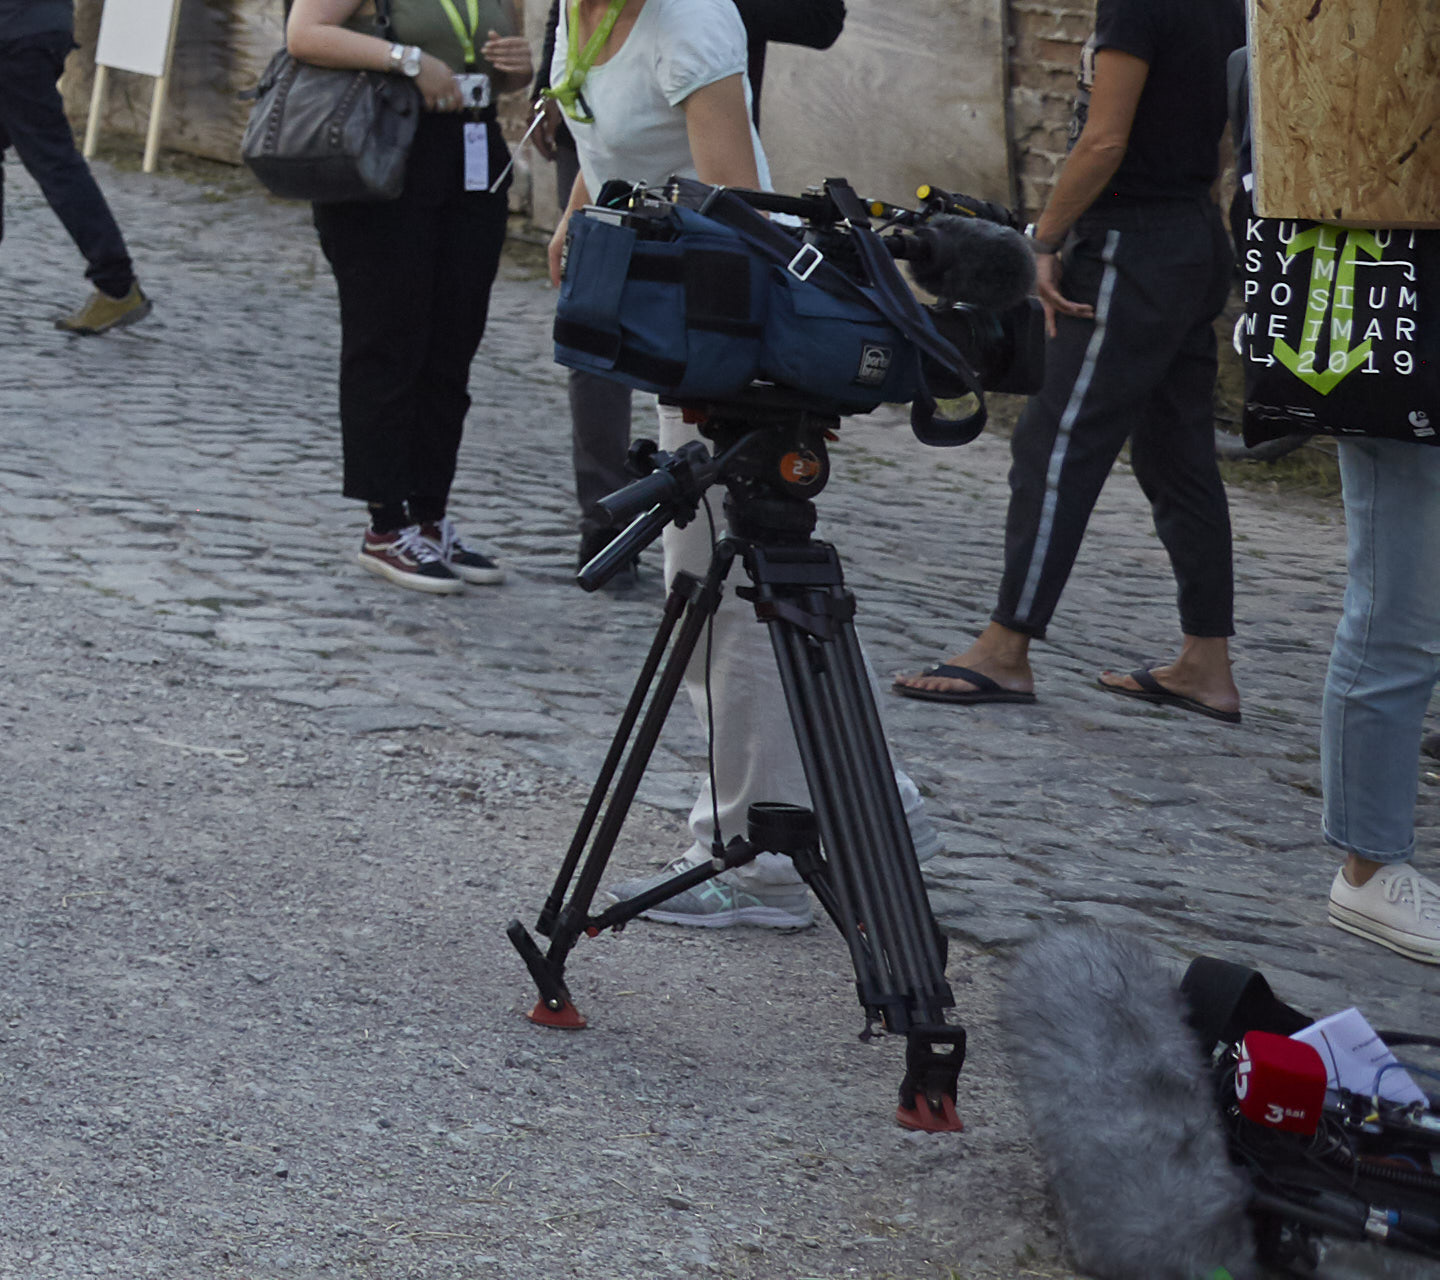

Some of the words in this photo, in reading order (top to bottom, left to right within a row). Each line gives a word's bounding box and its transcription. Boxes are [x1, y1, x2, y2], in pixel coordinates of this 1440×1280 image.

[1244, 280, 1418, 312] POSIUM
[1244, 313, 1417, 342] WEIMAR
[1297, 350, 1414, 375] 2019
